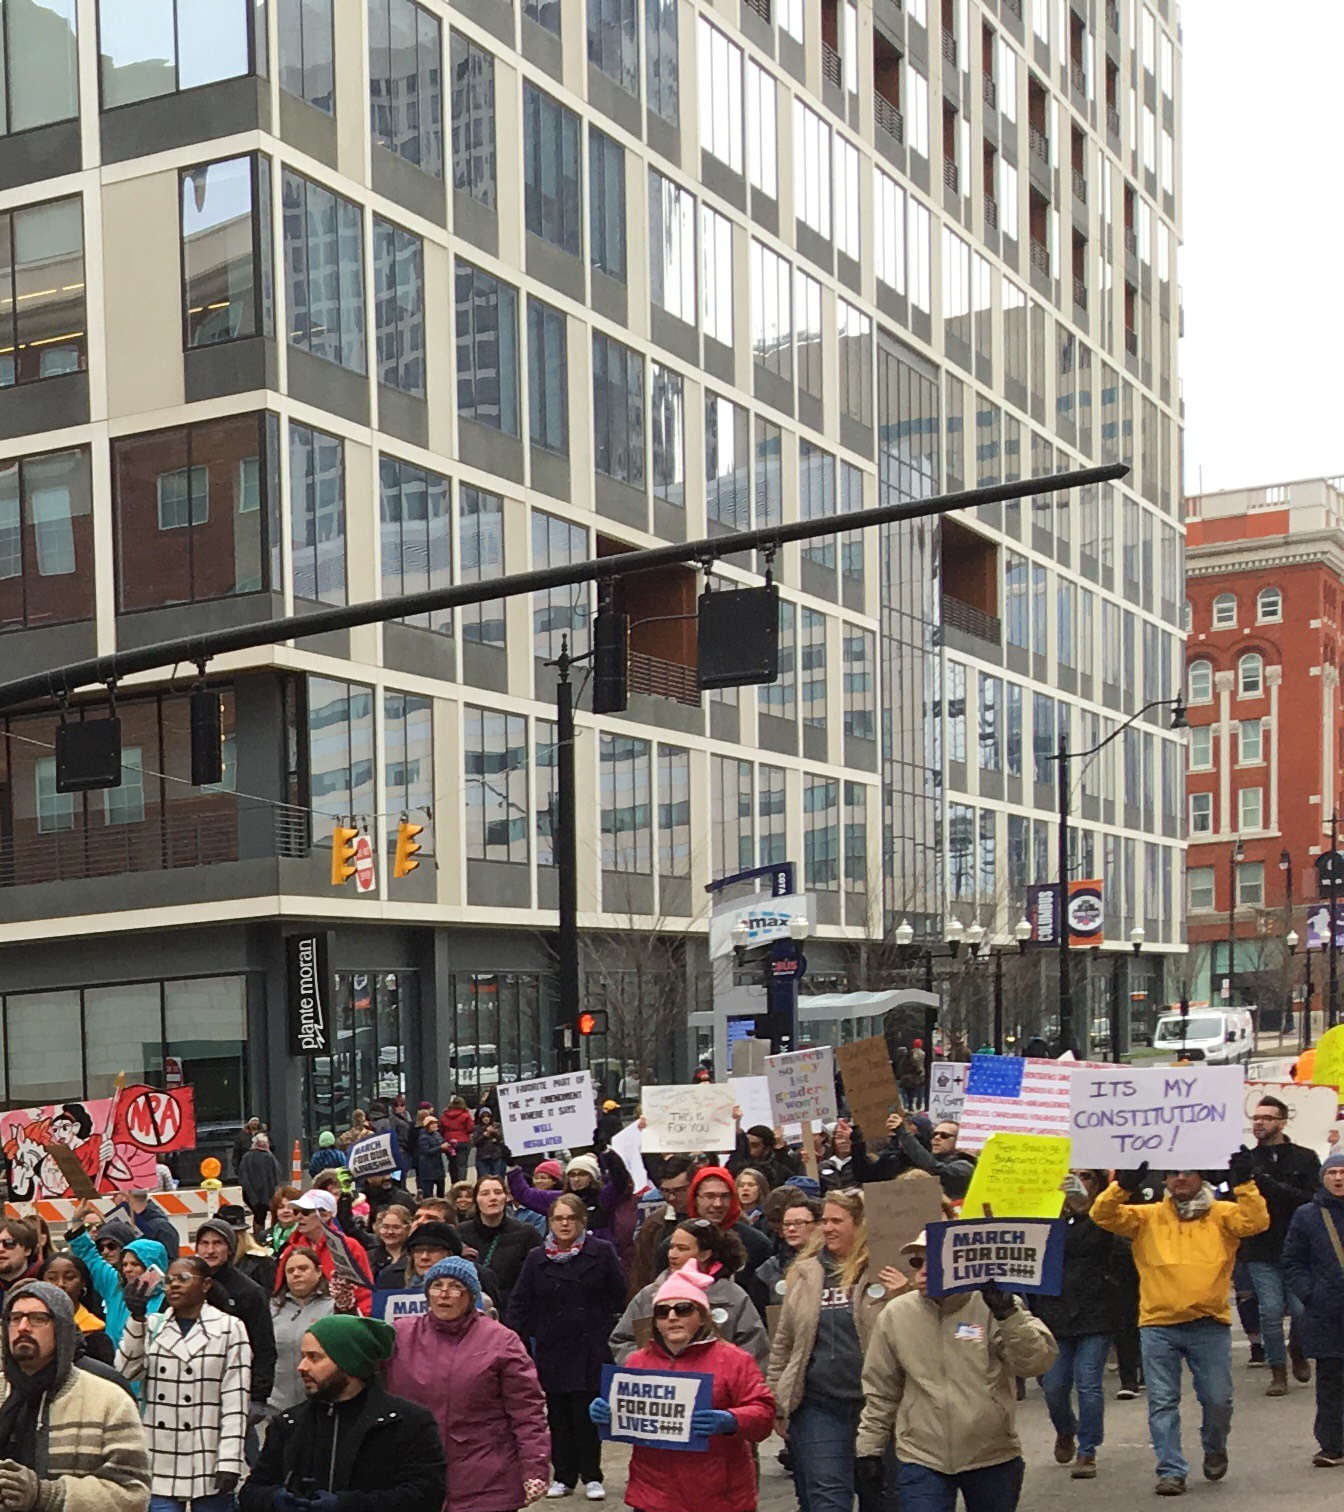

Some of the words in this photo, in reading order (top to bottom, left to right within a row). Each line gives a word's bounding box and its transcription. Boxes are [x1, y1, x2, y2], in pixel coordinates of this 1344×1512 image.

[299, 939, 313, 995] moran
[298, 997, 318, 1049] plante
[499, 1088, 510, 1097] MY
[516, 1081, 548, 1094] FAVORITE
[553, 1078, 571, 1088] PART
[576, 1075, 585, 1084] OF
[1163, 1078, 1198, 1098] MY
[508, 1100, 520, 1110] THE
[540, 1091, 582, 1105] AMENDMENT
[509, 1114, 517, 1122] IS
[520, 1110, 543, 1120] WHERE
[548, 1108, 554, 1116] IT
[558, 1105, 576, 1115] SAYS
[1074, 1103, 1227, 1129] CONSTITUTION
[533, 1123, 553, 1133] WELL
[668, 1122, 687, 1132] FOR
[691, 1122, 709, 1133] YOU
[355, 1140, 381, 1154] MARCH
[523, 1136, 562, 1149] REGULATED
[353, 1154, 369, 1165] FOR
[370, 1149, 388, 1160] OUR
[953, 1230, 1026, 1247] MARCH
[953, 1248, 993, 1264] FOR
[996, 1246, 1037, 1262] OUR
[953, 1262, 1008, 1281] LIVES
[394, 1301, 428, 1315] MAR
[617, 1381, 676, 1400] MARCH
[617, 1398, 647, 1415] FOR
[649, 1401, 686, 1418] OUR
[618, 1415, 659, 1435] LIVES
